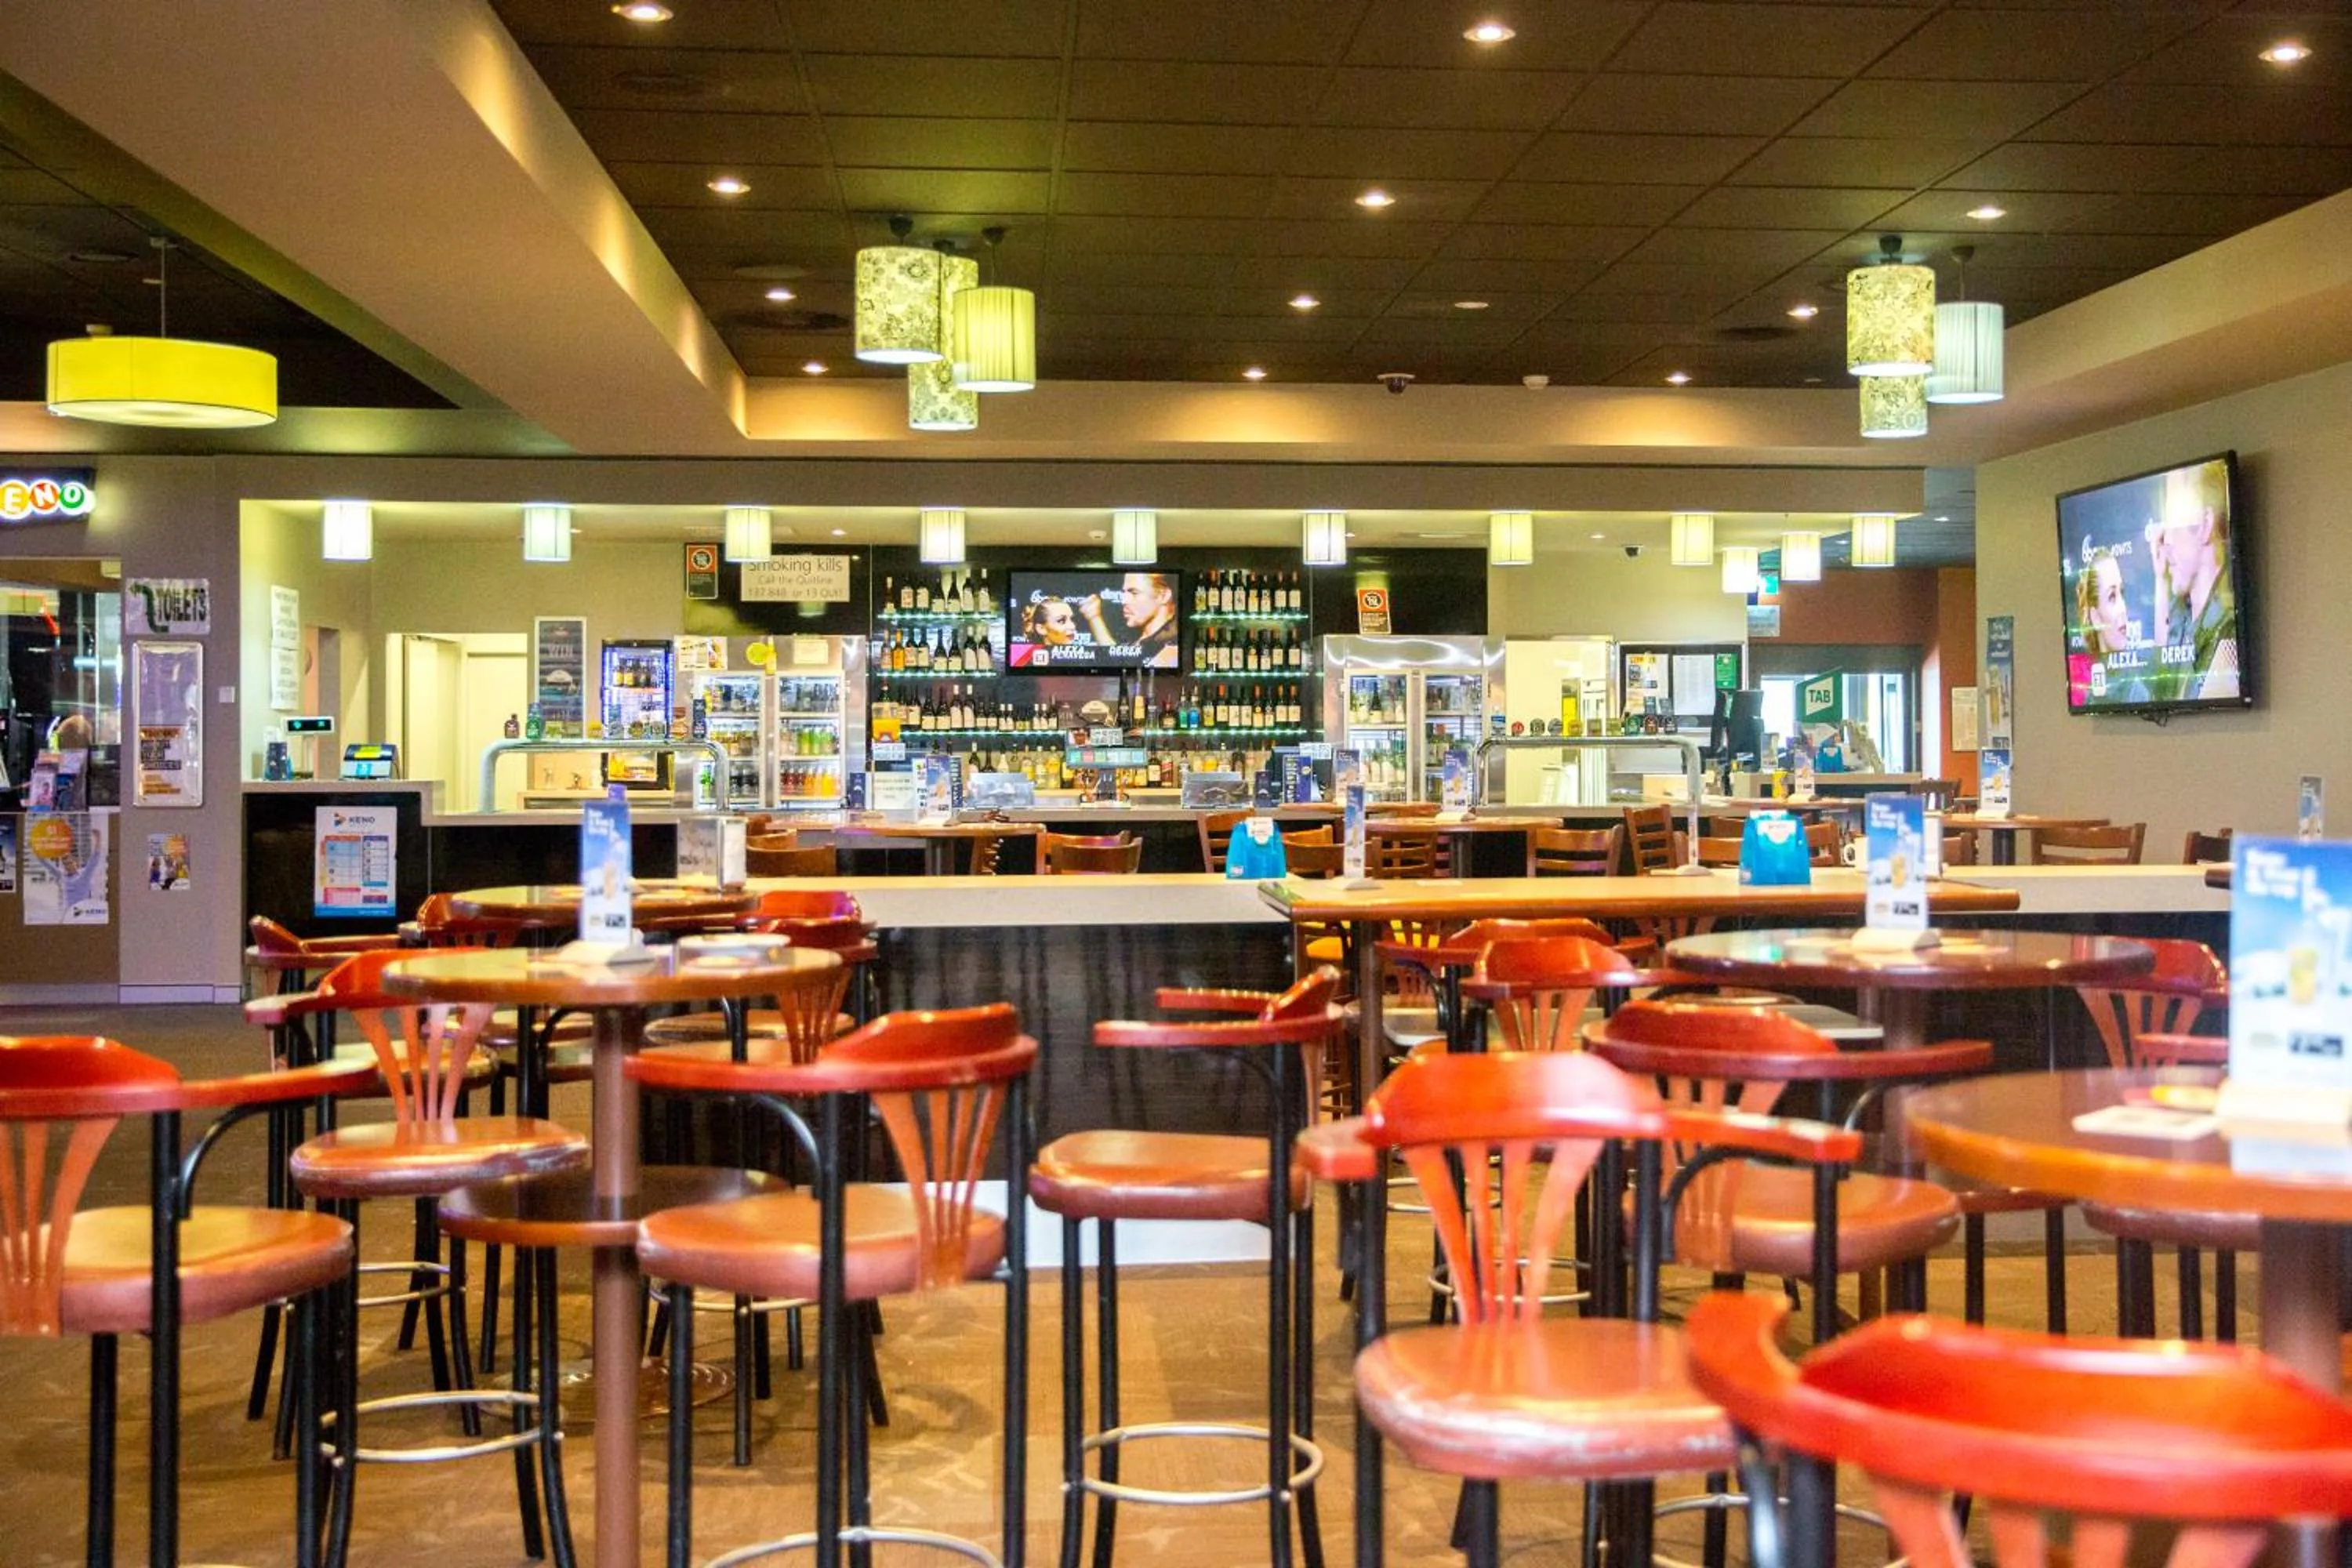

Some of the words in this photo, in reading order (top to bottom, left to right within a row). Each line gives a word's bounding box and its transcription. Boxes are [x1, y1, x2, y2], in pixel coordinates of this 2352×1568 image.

[818, 557, 843, 572] kills
[156, 589, 205, 621] TOILETS
[1809, 689, 1831, 703] TAB
